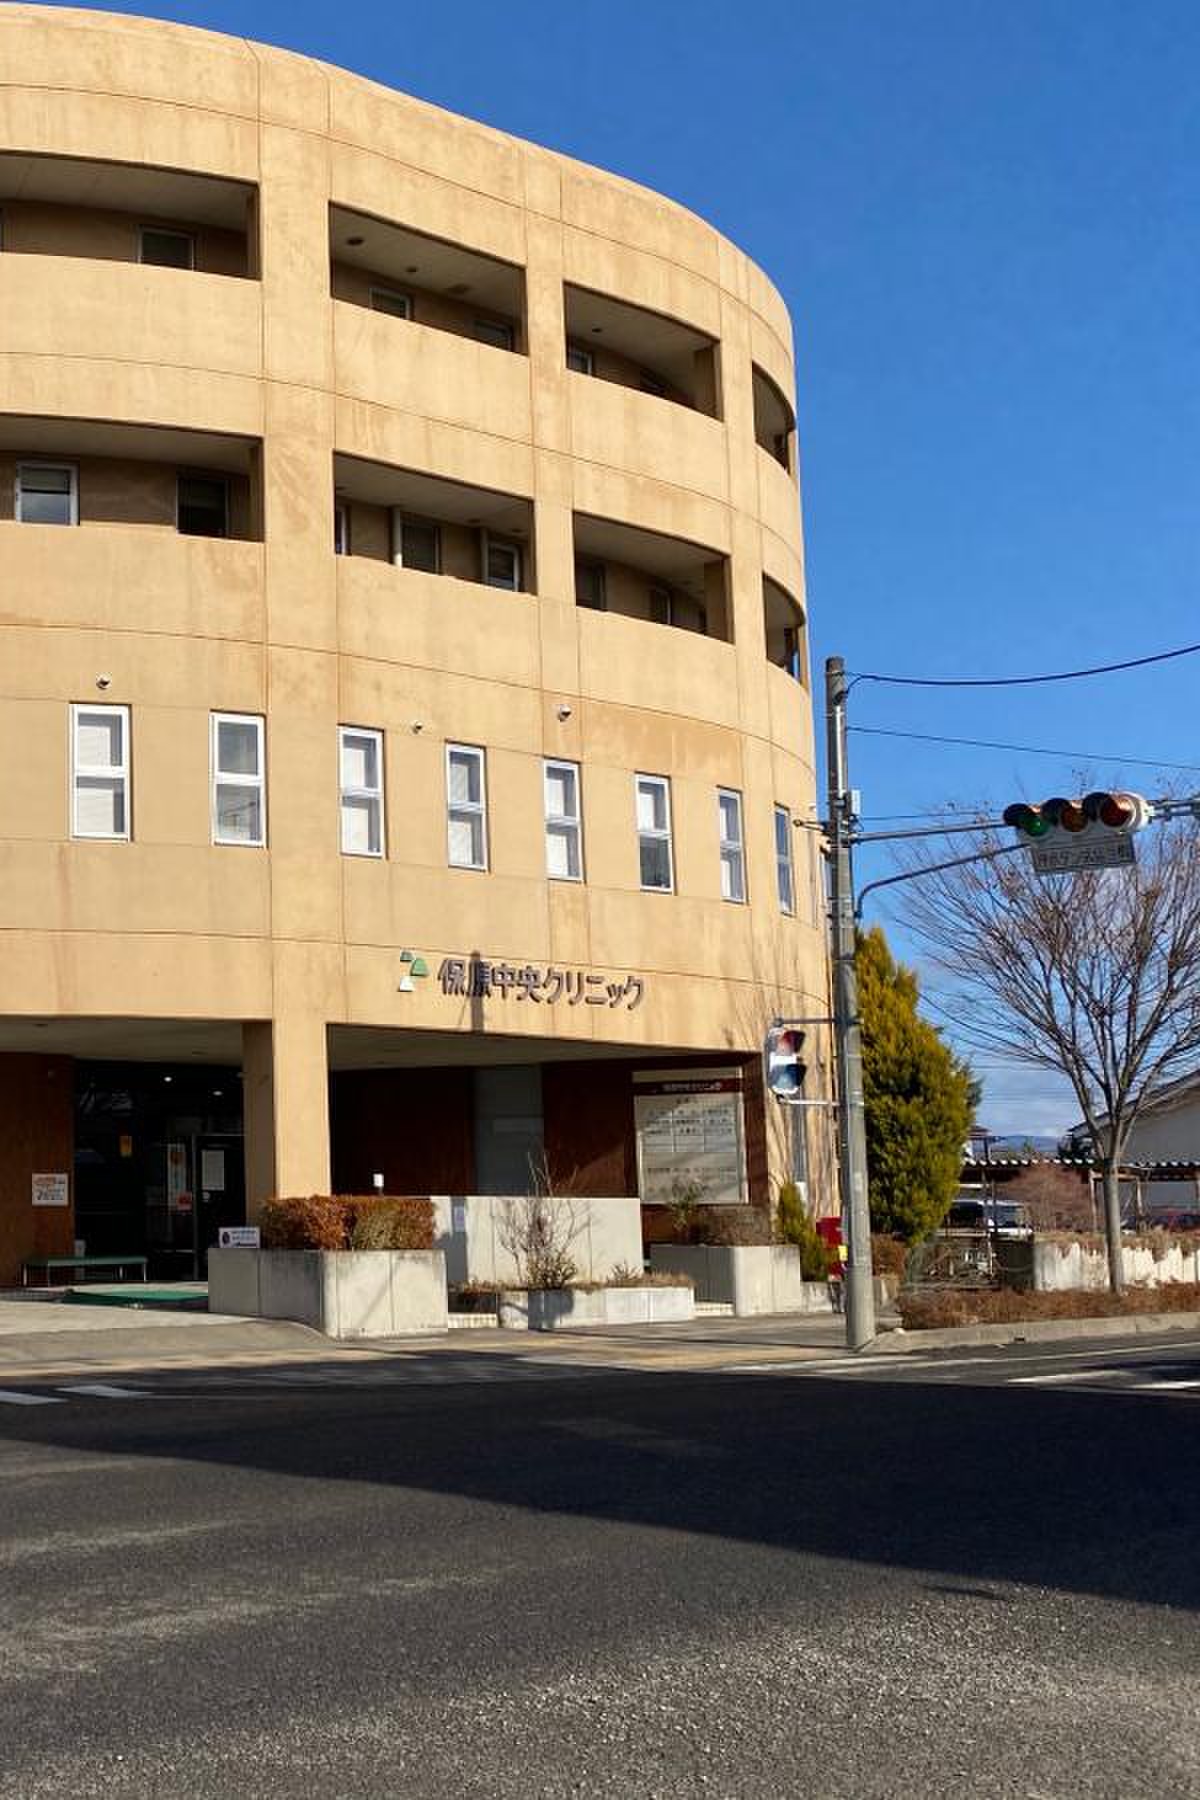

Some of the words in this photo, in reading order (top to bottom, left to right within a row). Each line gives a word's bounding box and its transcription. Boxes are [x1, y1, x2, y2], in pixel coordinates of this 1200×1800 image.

[437, 958, 644, 1009] 保原中央クリニック
